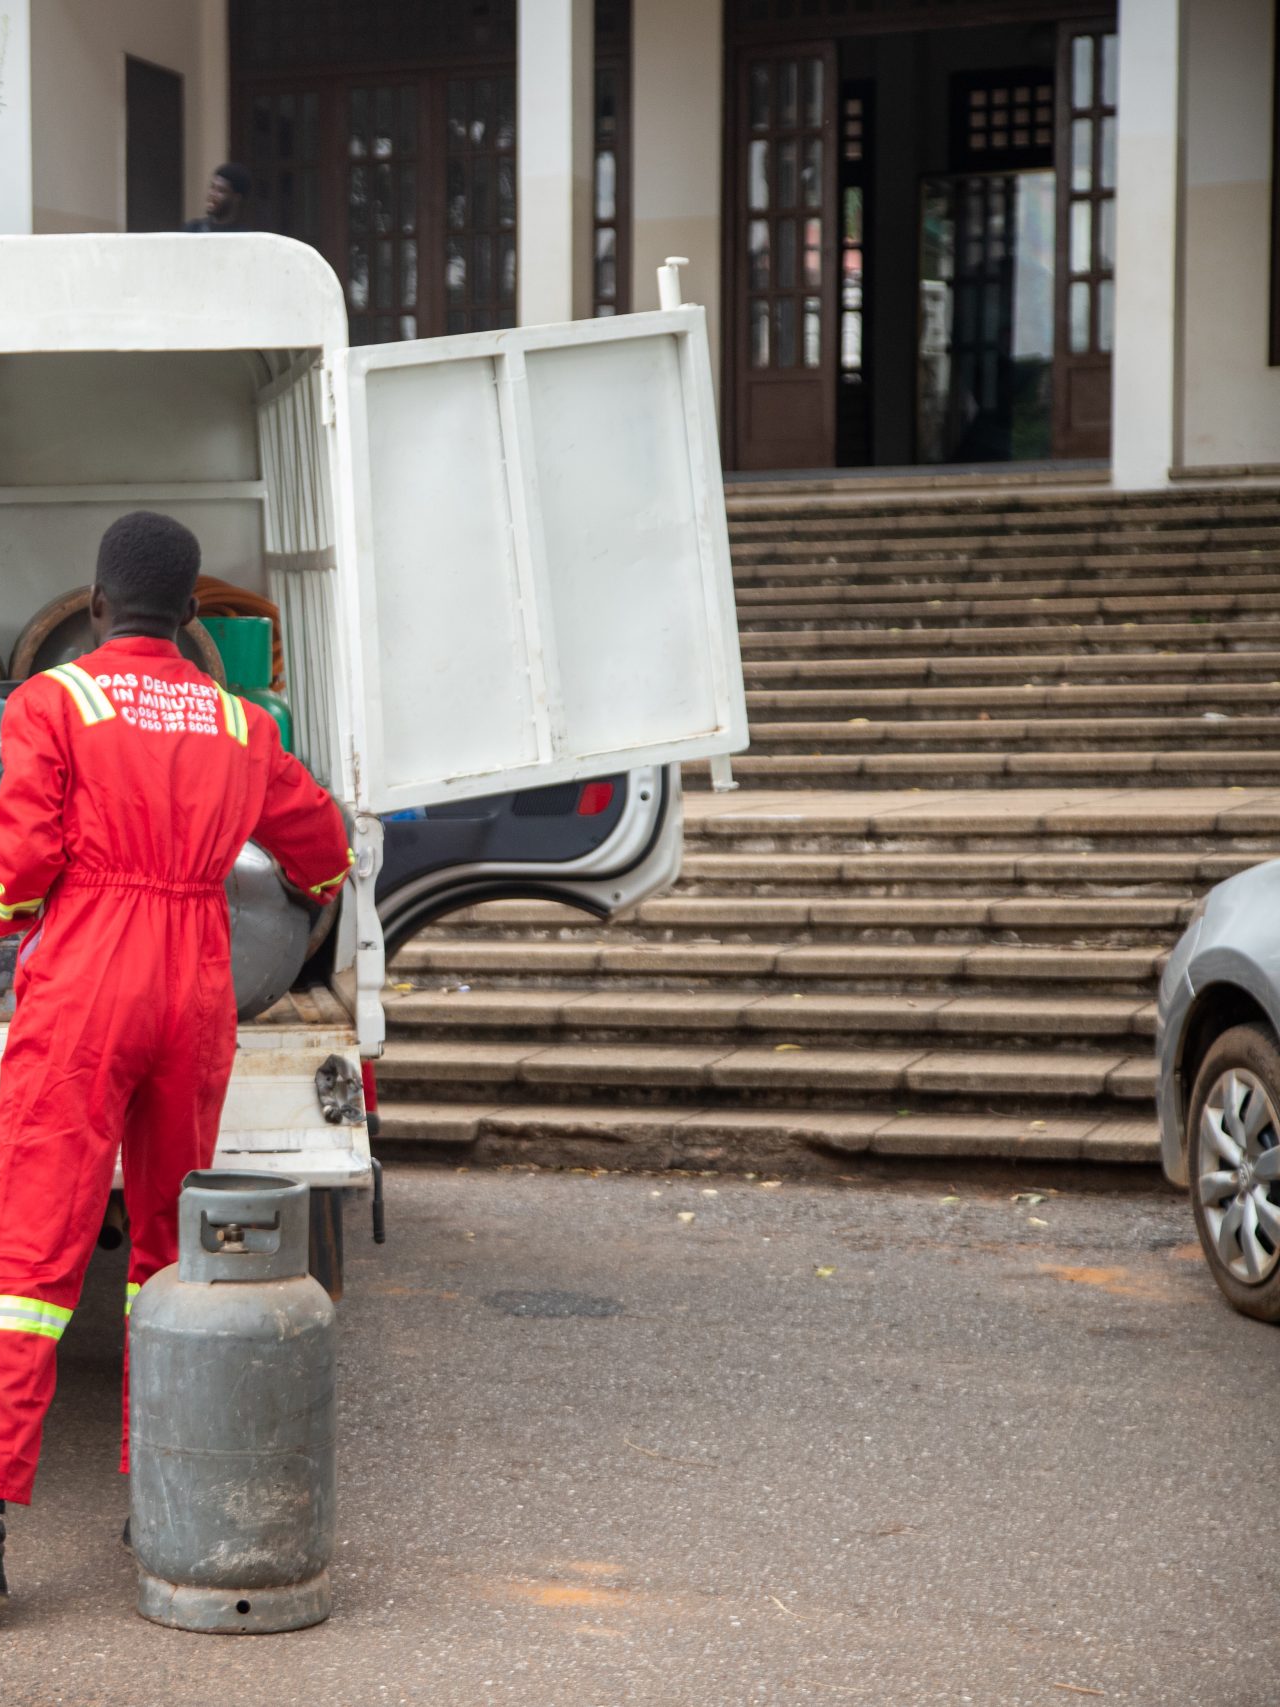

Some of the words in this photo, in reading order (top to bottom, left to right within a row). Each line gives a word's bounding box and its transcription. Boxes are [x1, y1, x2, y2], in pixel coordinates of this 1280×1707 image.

[95, 673, 138, 687] GAS
[142, 674, 218, 700] DELIVERY
[112, 688, 134, 702] IN
[139, 691, 216, 713] MINUTES
